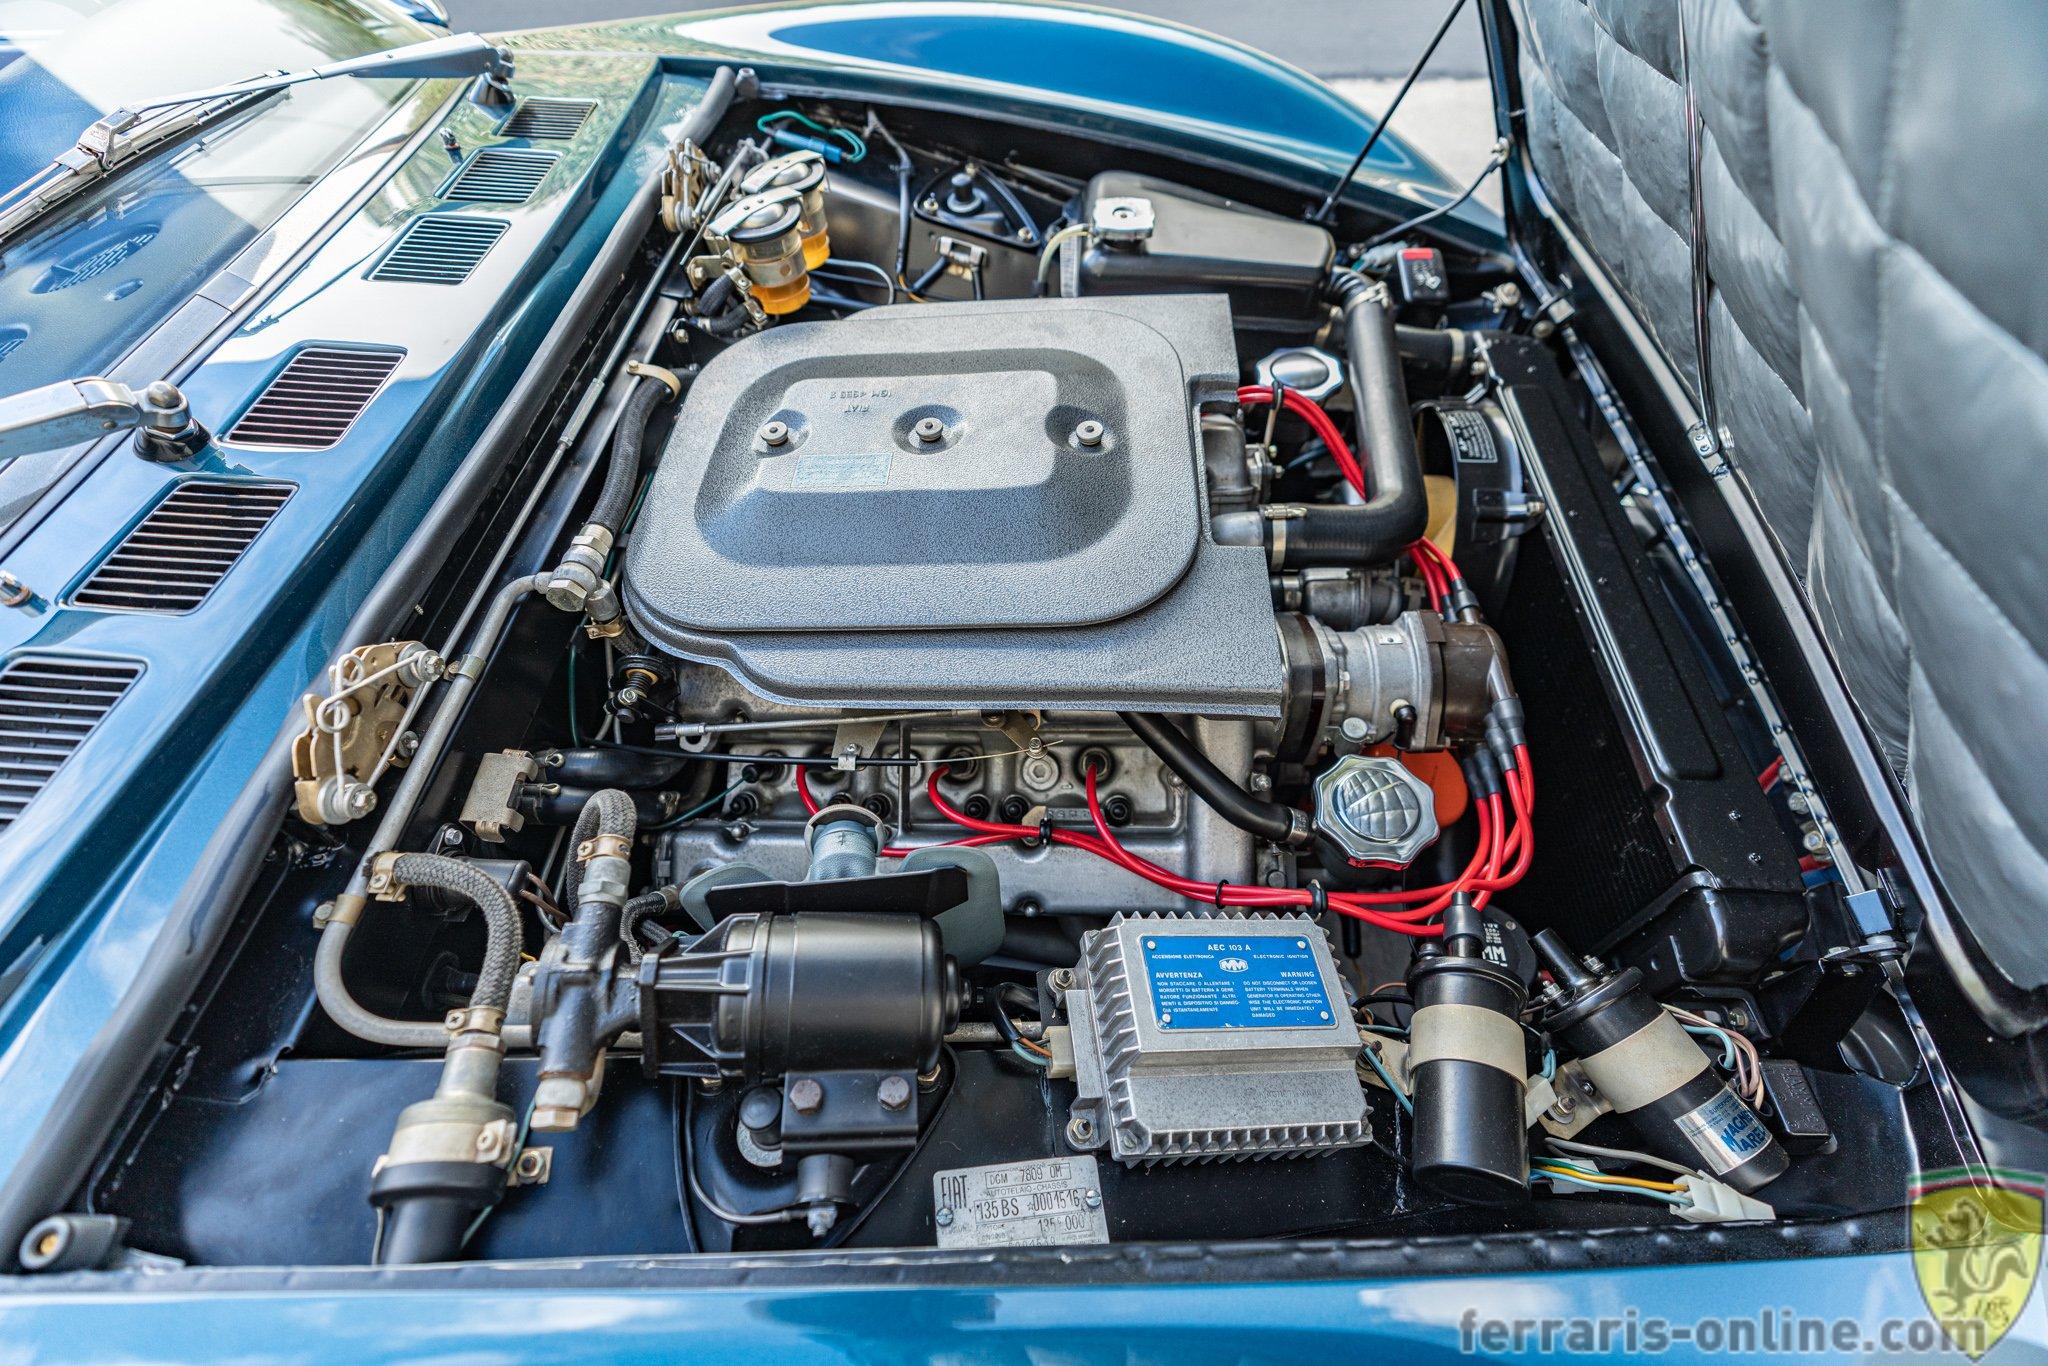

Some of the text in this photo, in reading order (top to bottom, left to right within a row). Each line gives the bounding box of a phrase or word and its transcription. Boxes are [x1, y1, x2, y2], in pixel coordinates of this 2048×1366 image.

[844, 404, 870, 413] FIAT
[989, 1172, 1009, 1186] DGM
[1020, 1166, 1044, 1183] 7809
[941, 1174, 968, 1210] FIAT
